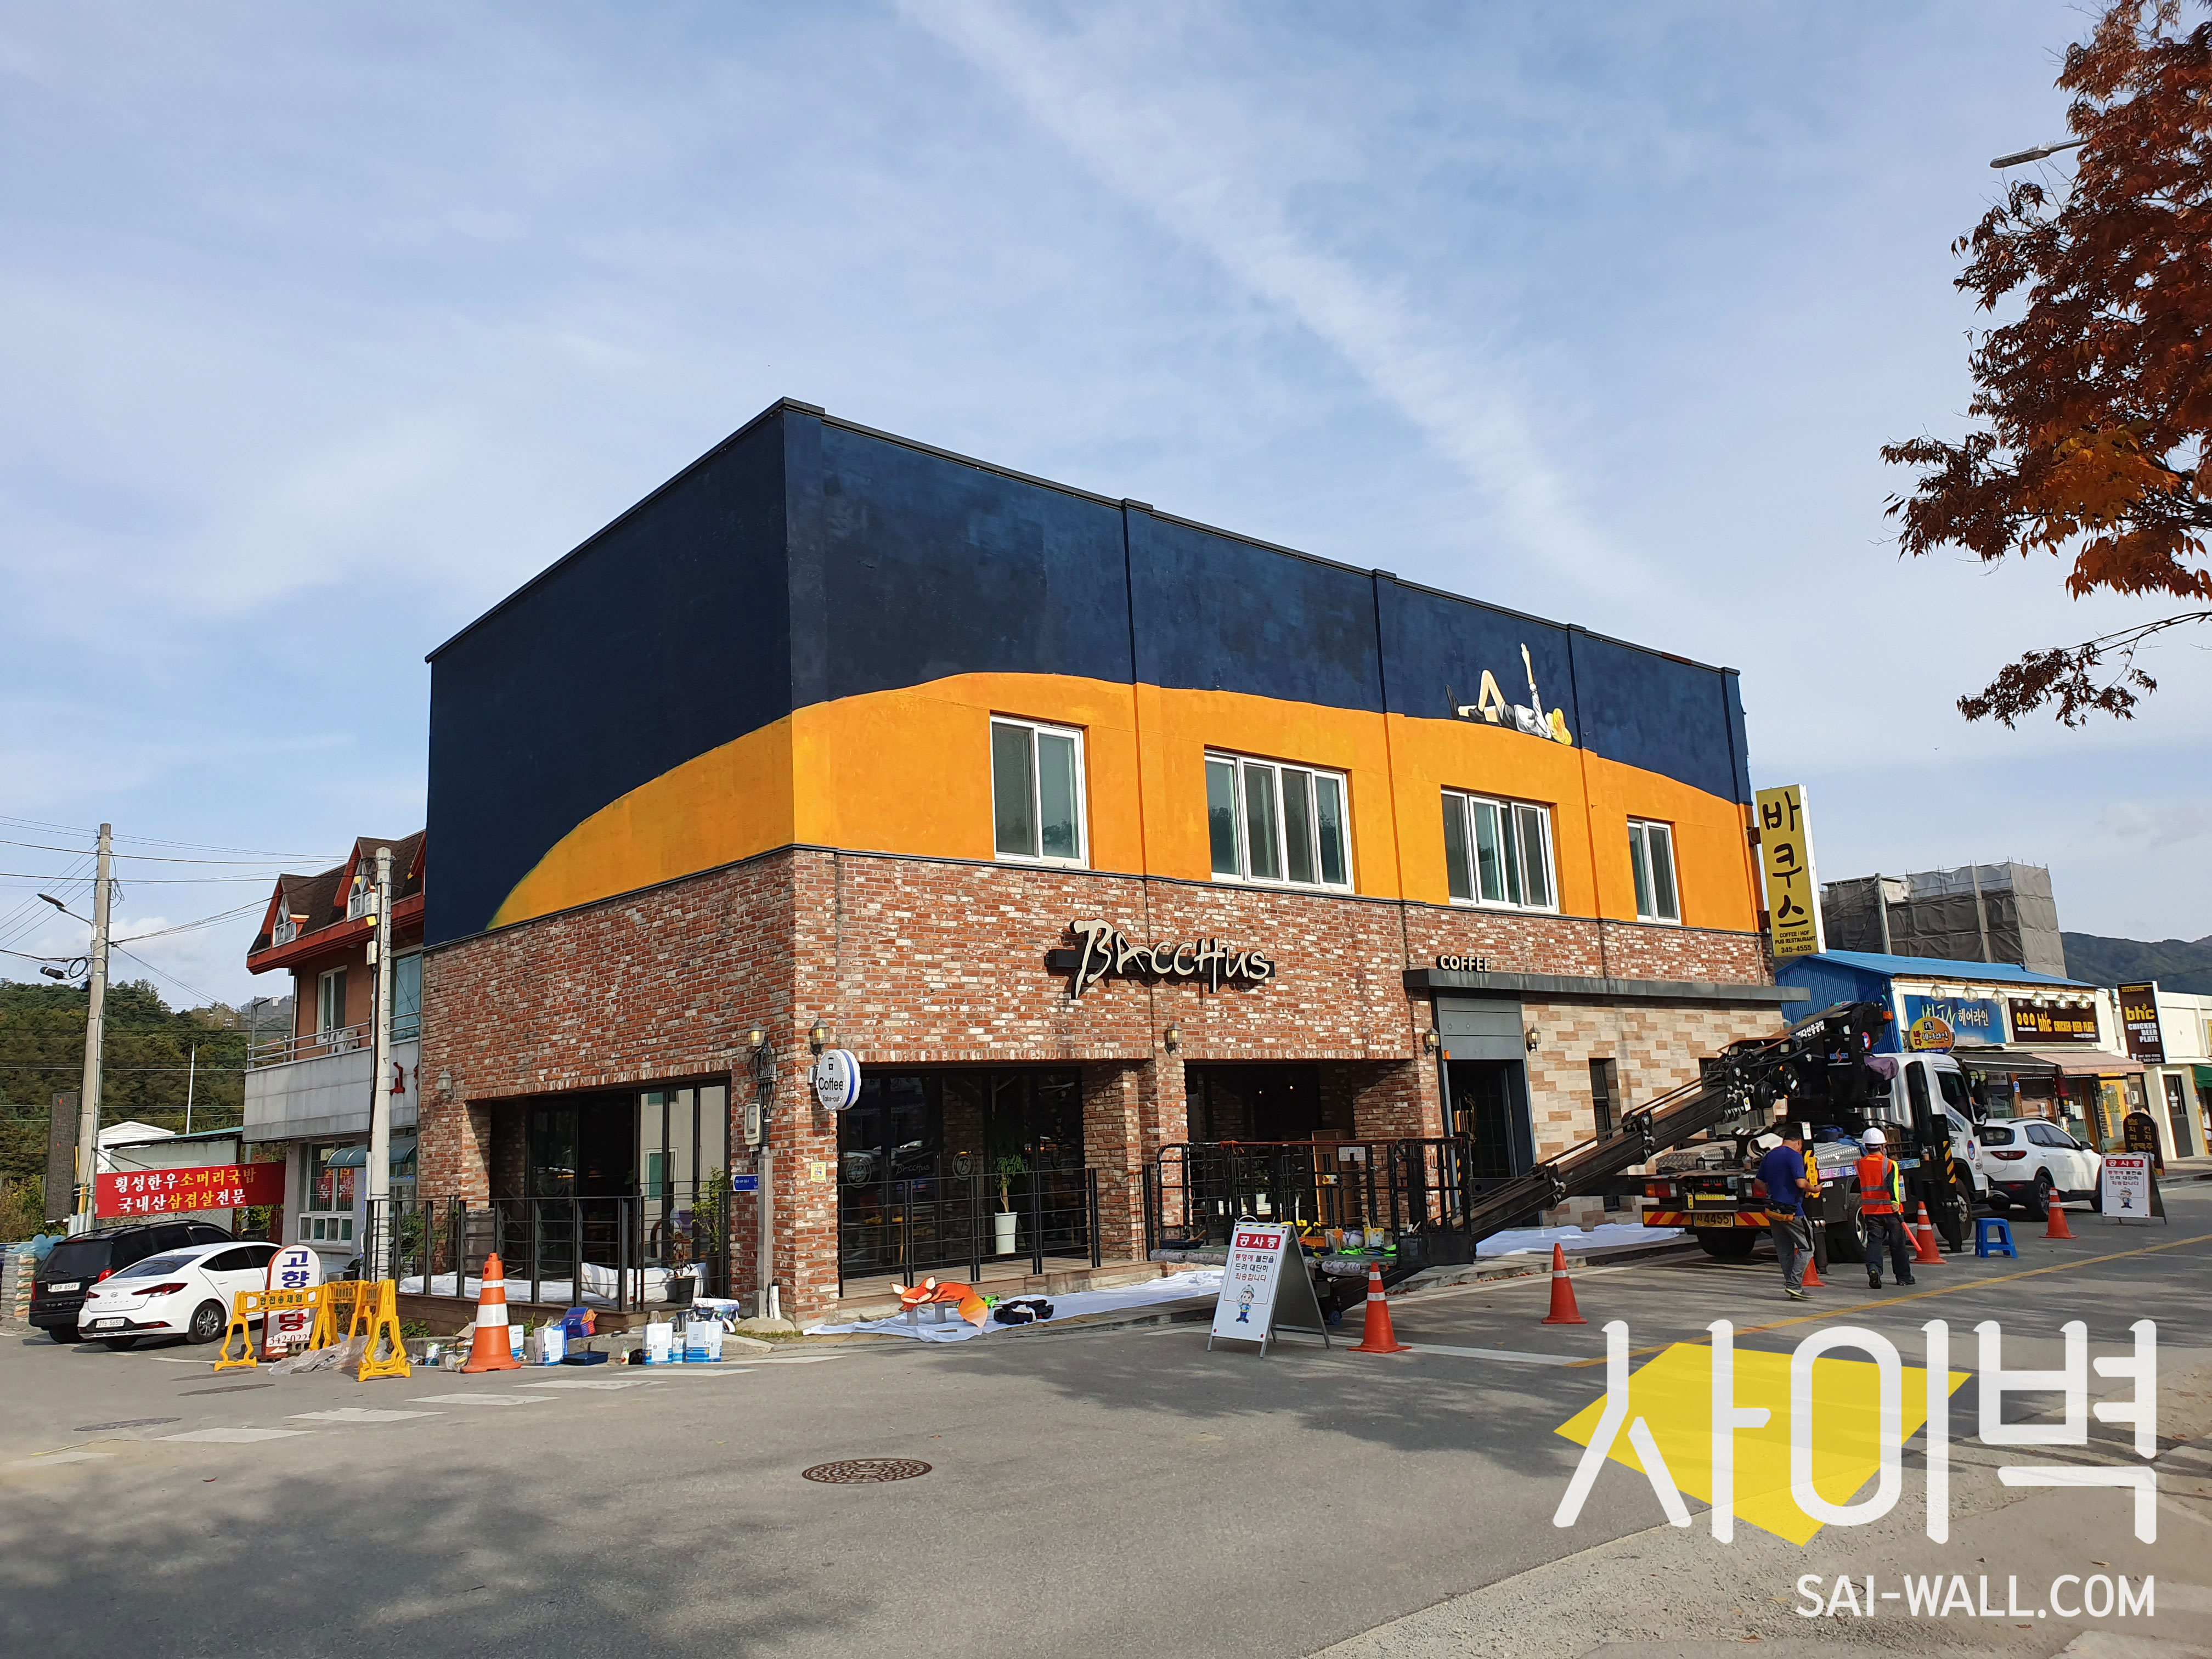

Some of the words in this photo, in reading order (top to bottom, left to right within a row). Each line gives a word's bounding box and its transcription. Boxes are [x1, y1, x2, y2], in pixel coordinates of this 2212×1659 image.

[1762, 791, 1808, 927] 바쿠스
[1781, 944, 1812, 953] 345-4555
[1438, 955, 1491, 972] COFFEE
[1957, 1008, 1989, 1027] 헤어라인
[2125, 1005, 2155, 1021] bhc
[2037, 1011, 2052, 1032] bhc
[818, 1077, 844, 1091] Coffee
[1240, 1235, 1278, 1248] 공사중
[1235, 1272, 1267, 1282] 죄송합니다
[279, 1250, 310, 1331] 고향당
[260, 1296, 275, 1305] 안전
[286, 1294, 303, 1304] 제일
[269, 1334, 312, 1345] 342-022
